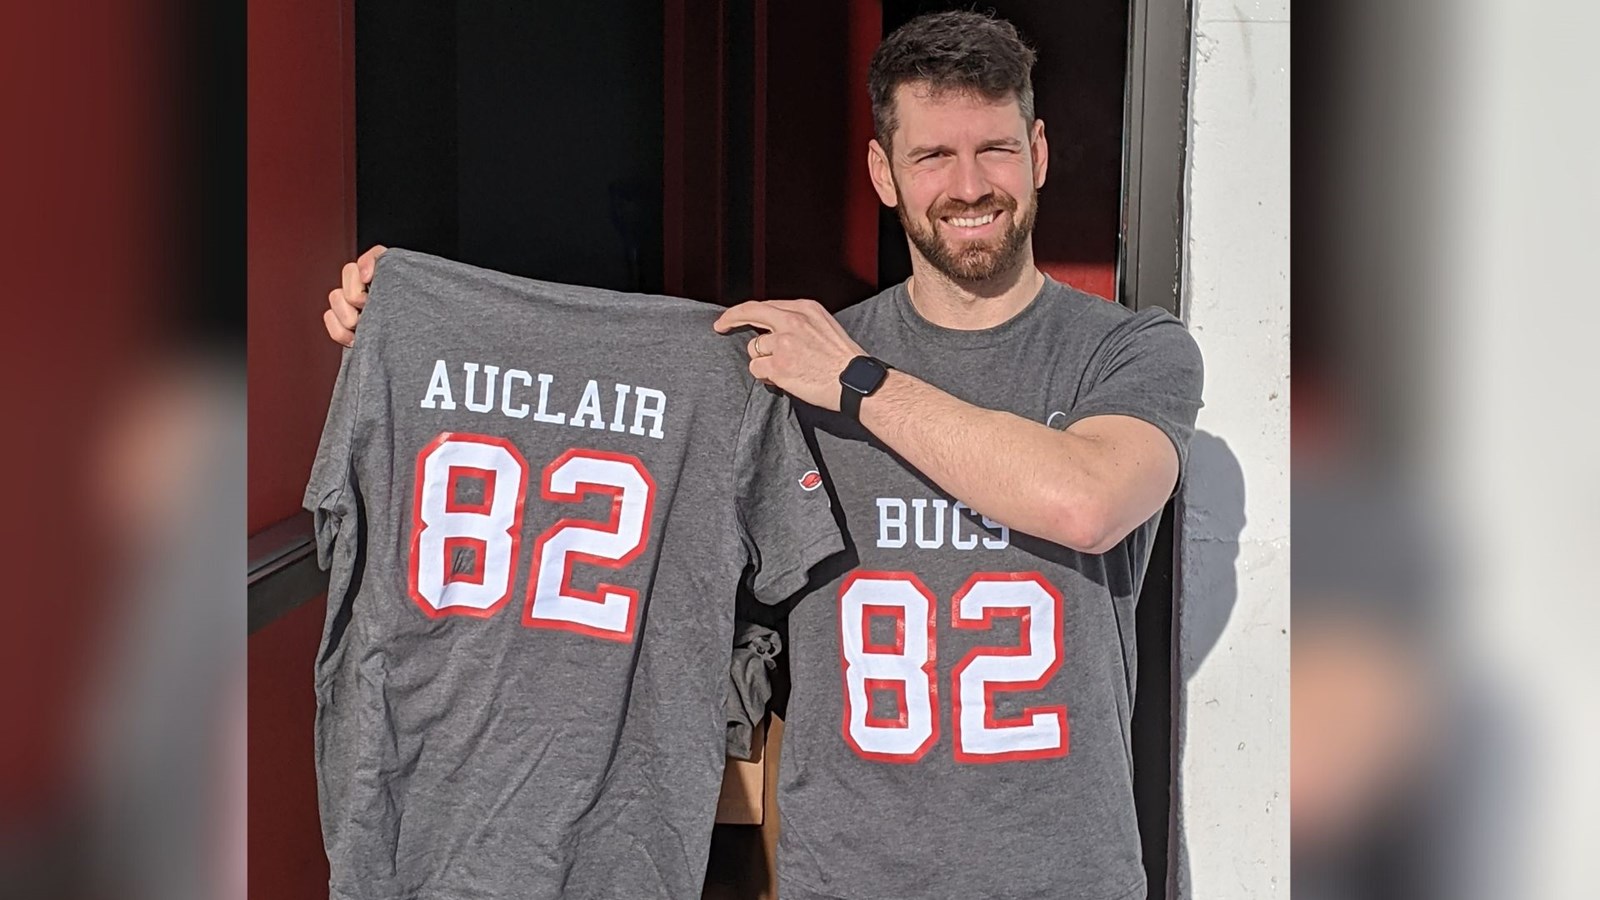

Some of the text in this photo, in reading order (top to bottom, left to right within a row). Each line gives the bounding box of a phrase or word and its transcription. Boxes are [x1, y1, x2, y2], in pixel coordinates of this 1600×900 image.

[420, 359, 667, 440] AUCLAIR
[407, 431, 657, 644] 82
[876, 498, 1010, 550] BUCS
[837, 569, 1070, 764] 82
